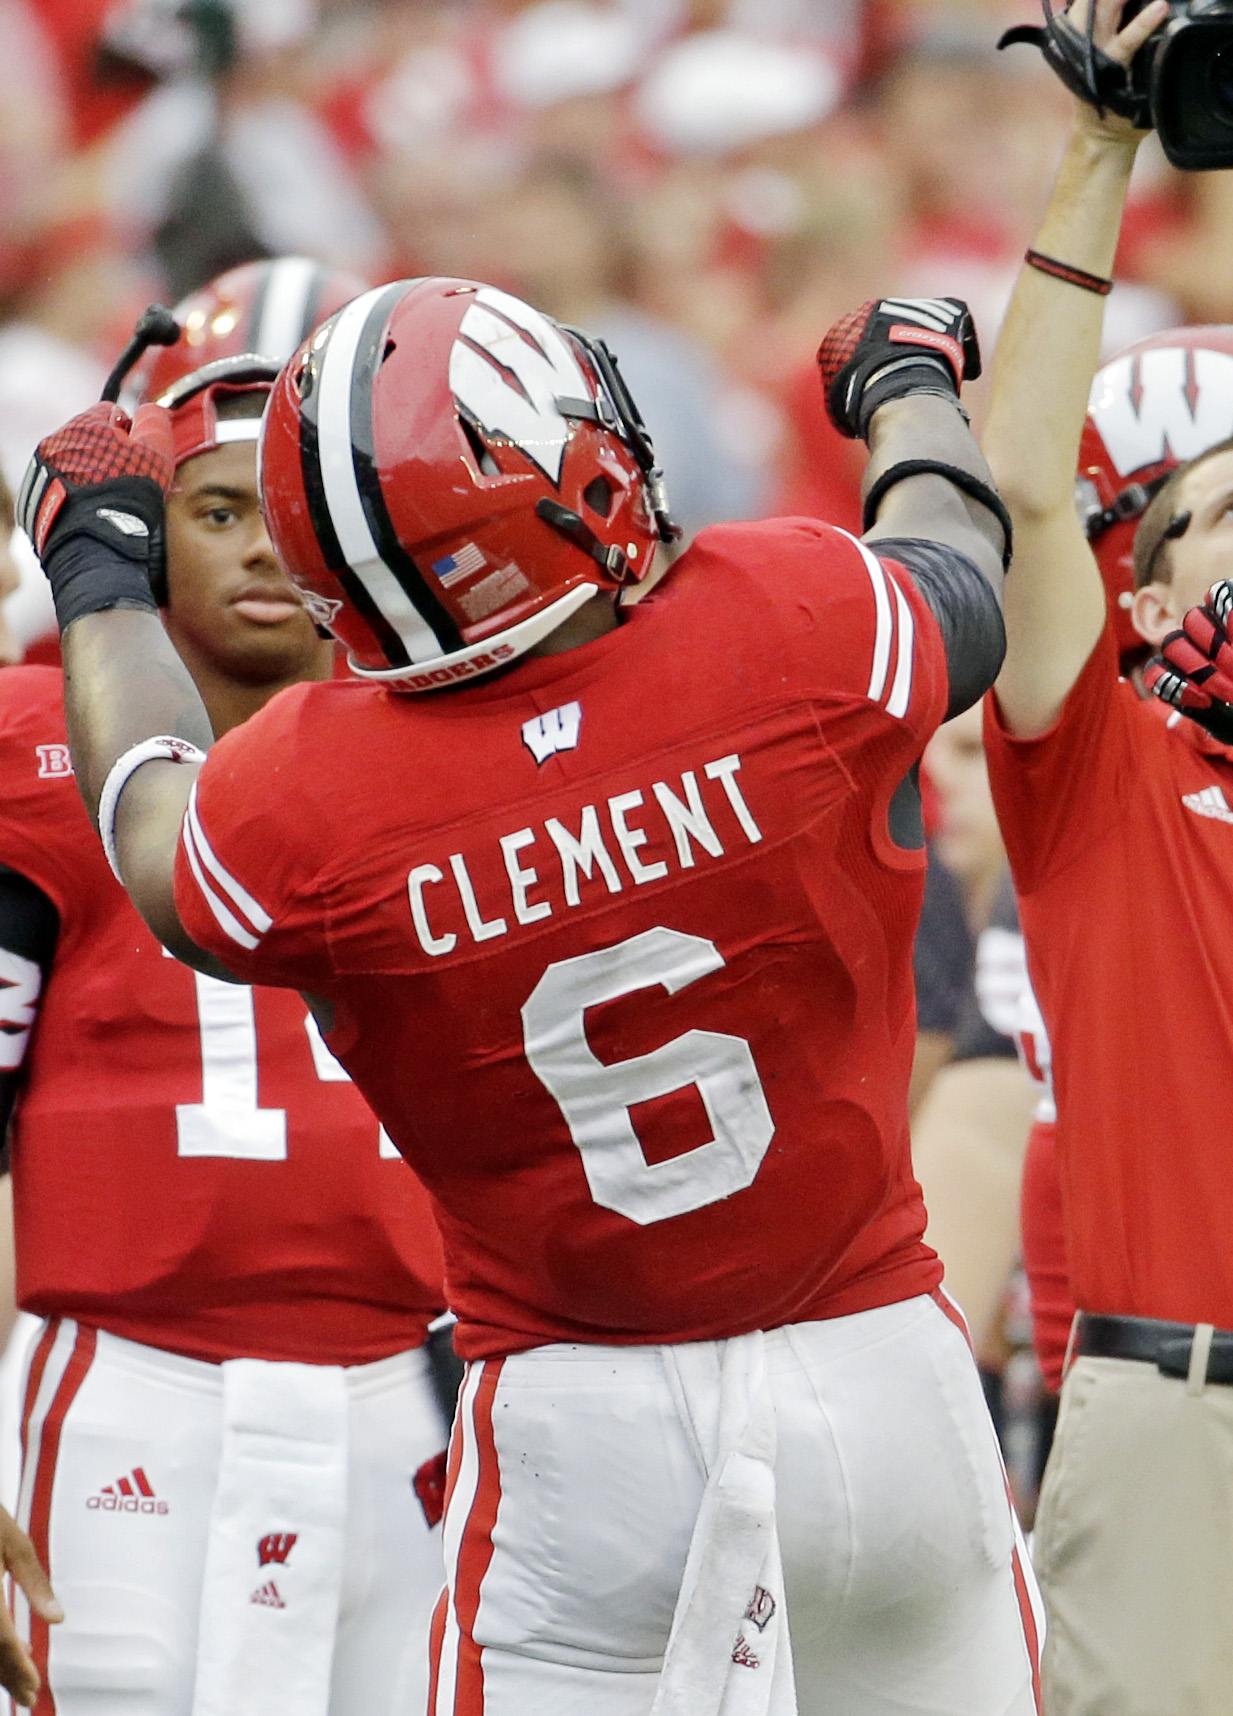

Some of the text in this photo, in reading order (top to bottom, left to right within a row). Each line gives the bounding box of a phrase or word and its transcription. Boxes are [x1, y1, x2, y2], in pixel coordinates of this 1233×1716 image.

[521, 700, 583, 765] W
[406, 753, 763, 957] CLEMENT
[520, 925, 776, 1226] 6
[86, 1495, 168, 1516] adidas
[256, 1531, 299, 1569] W
